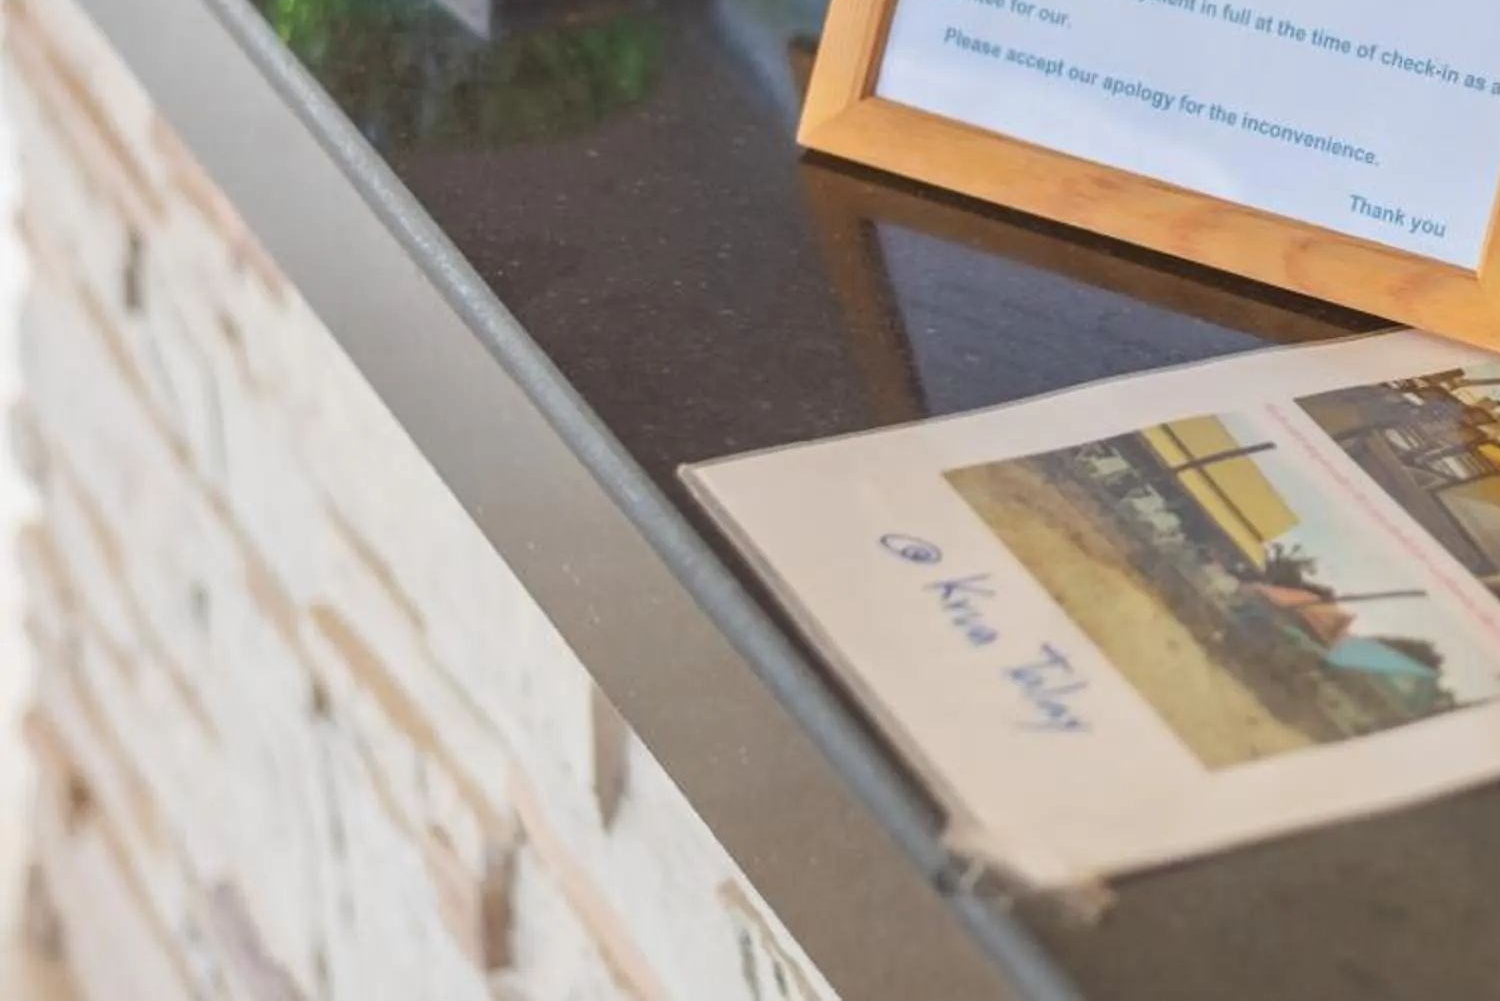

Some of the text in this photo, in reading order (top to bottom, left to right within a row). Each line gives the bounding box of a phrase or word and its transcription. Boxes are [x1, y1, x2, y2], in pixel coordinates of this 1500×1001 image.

[1222, 4, 1252, 27] full
[1255, 15, 1273, 33] at
[1277, 20, 1307, 42] the
[1311, 28, 1352, 55] time
[1356, 44, 1379, 61] of
[1380, 50, 1459, 84] check-in
[1464, 72, 1487, 91] as
[943, 26, 1381, 166] Please accept our apology for the inconvenience.
[1349, 195, 1446, 238] Thank you
